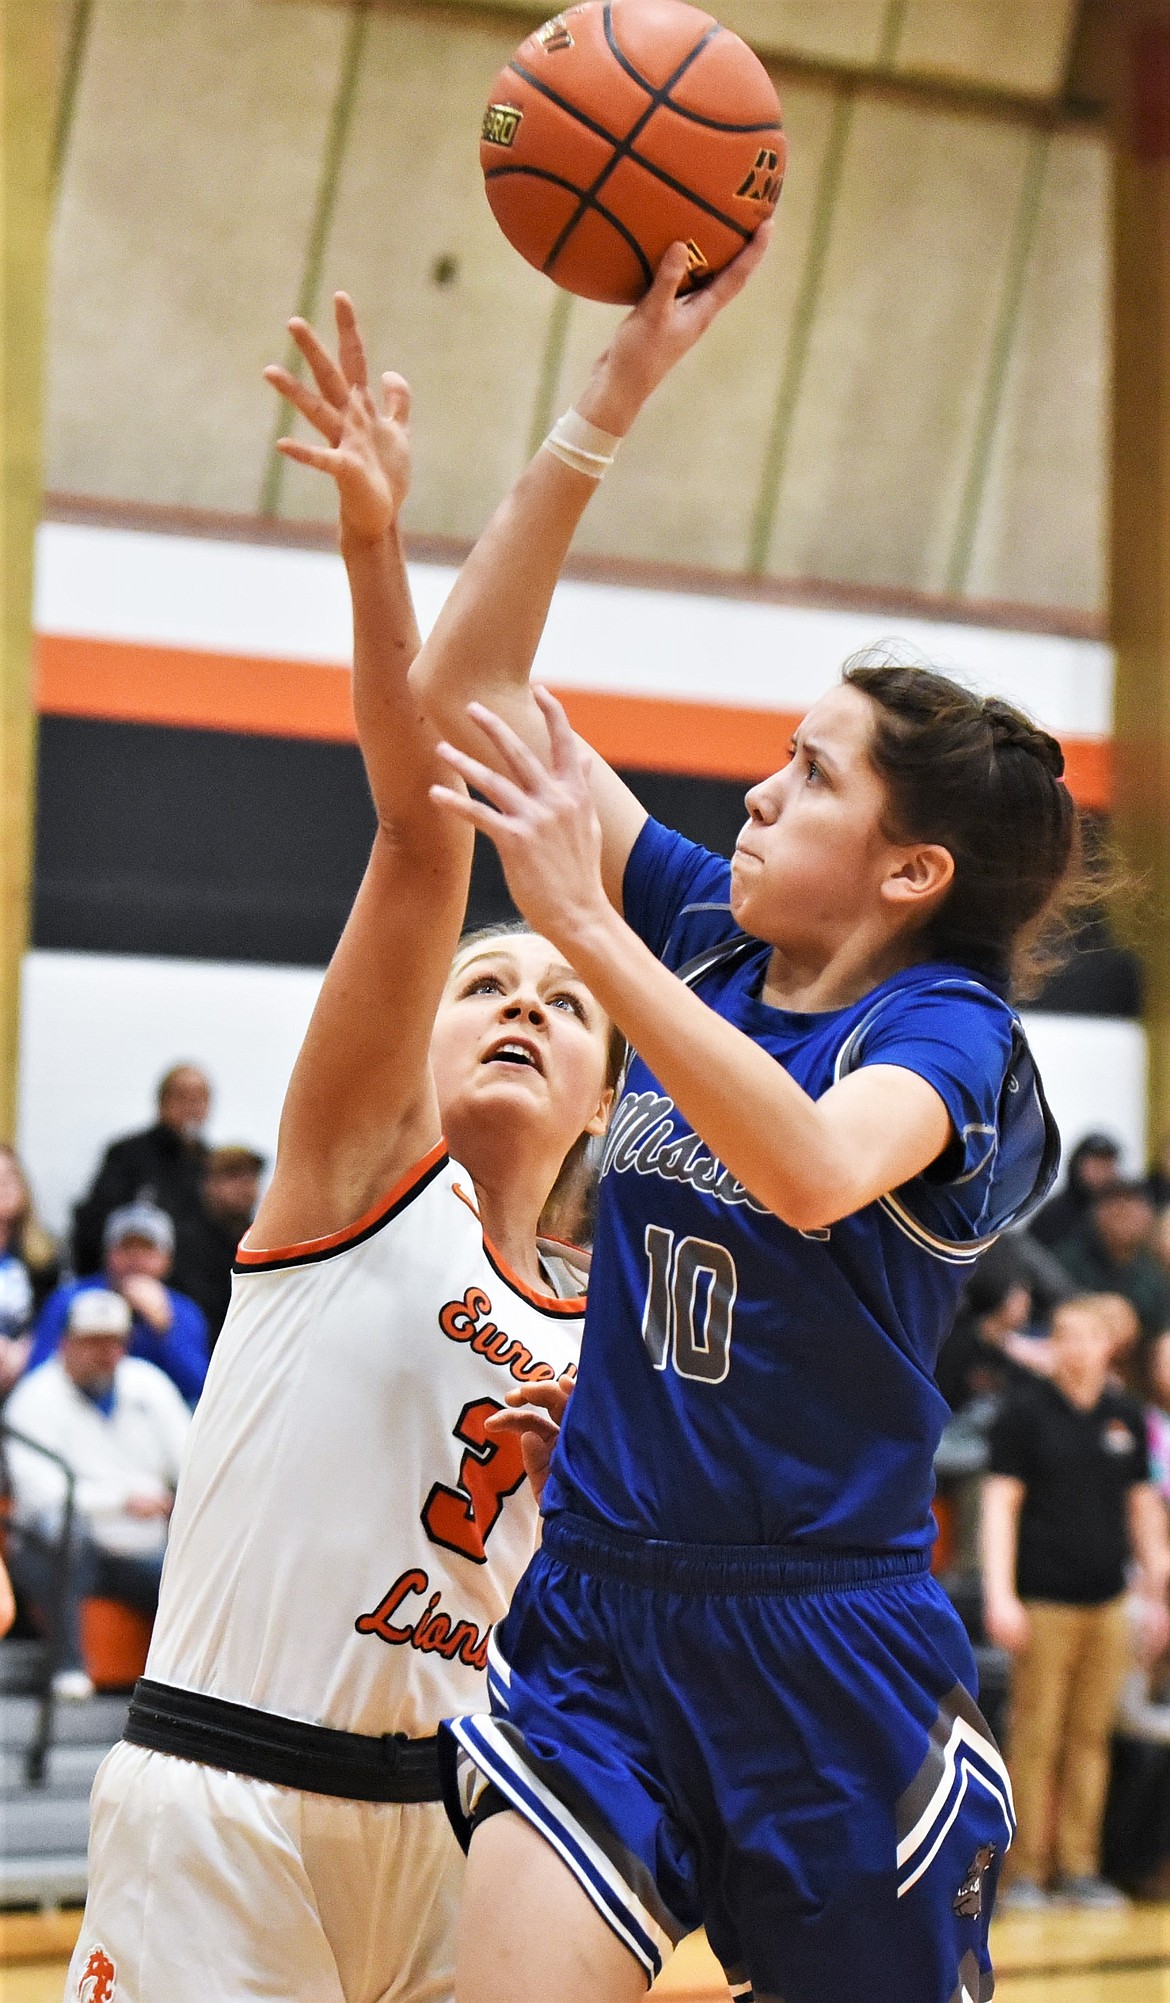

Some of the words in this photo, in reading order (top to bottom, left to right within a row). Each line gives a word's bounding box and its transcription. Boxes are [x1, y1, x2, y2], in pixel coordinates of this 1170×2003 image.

[438, 1286, 578, 1382] Eure
[642, 1223, 738, 1385] 10
[420, 1397, 529, 1565] 3
